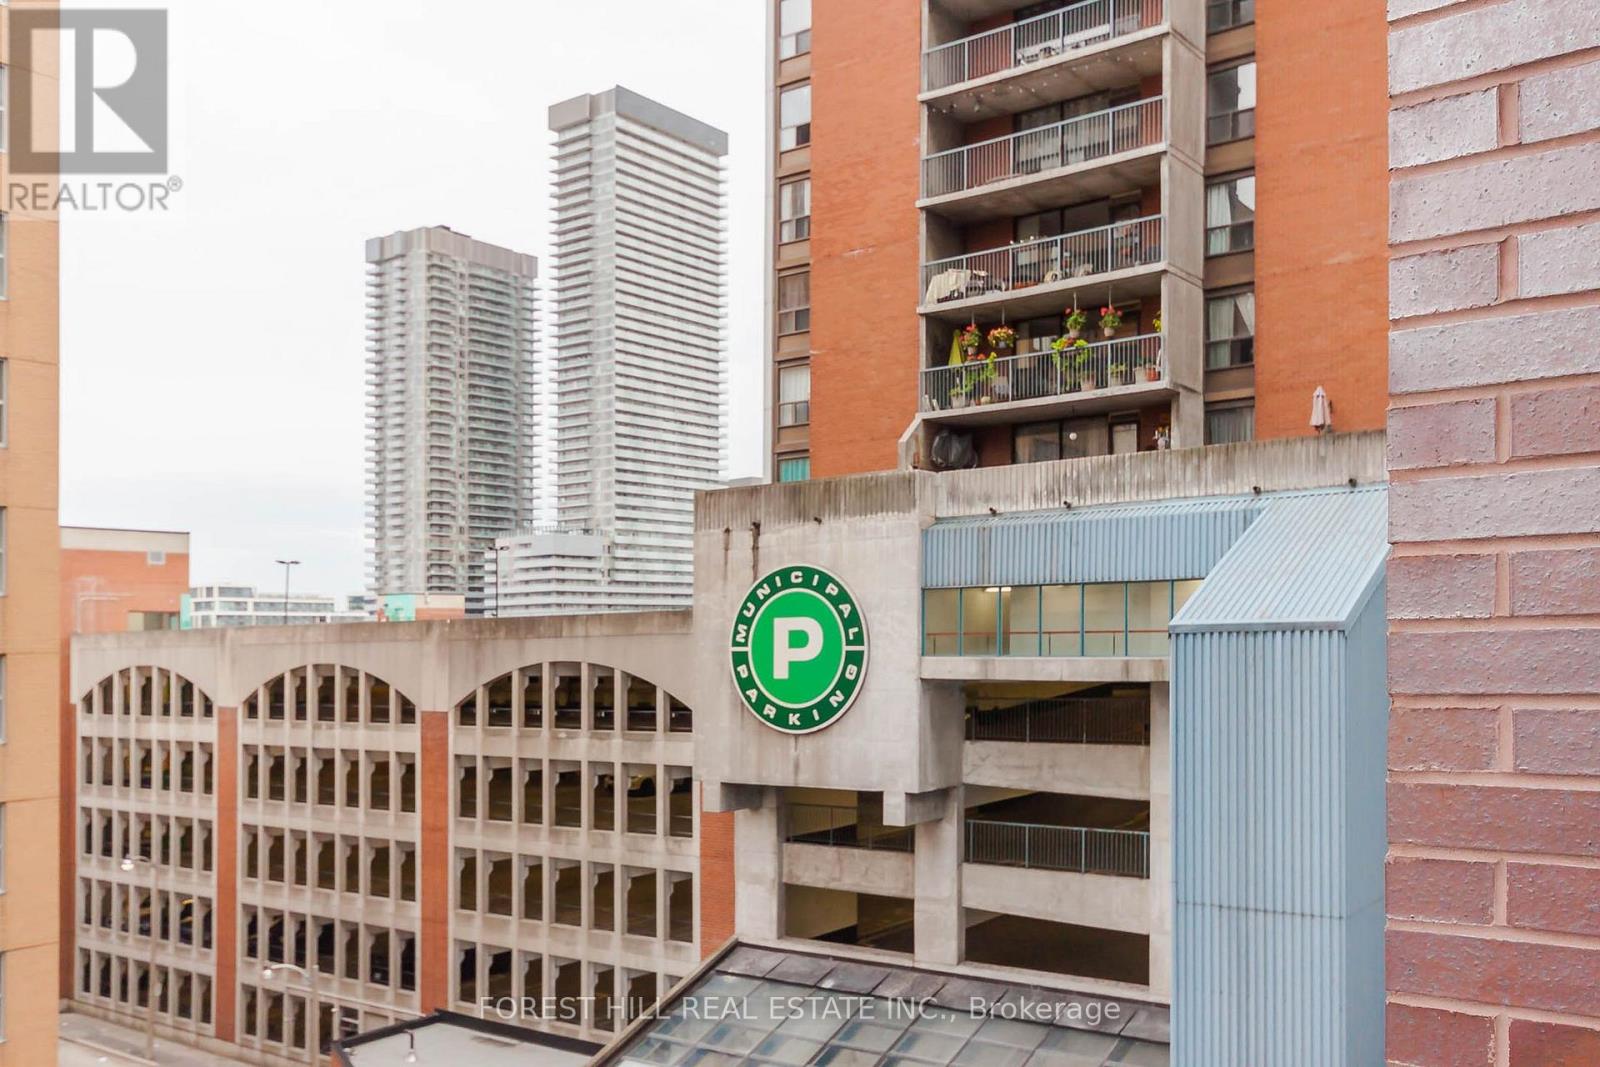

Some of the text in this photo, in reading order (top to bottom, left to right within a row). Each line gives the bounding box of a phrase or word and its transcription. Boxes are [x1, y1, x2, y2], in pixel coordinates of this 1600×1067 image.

[735, 570, 860, 644] MUNICIPAL
[772, 616, 825, 680] P
[736, 664, 858, 726] PARKING
